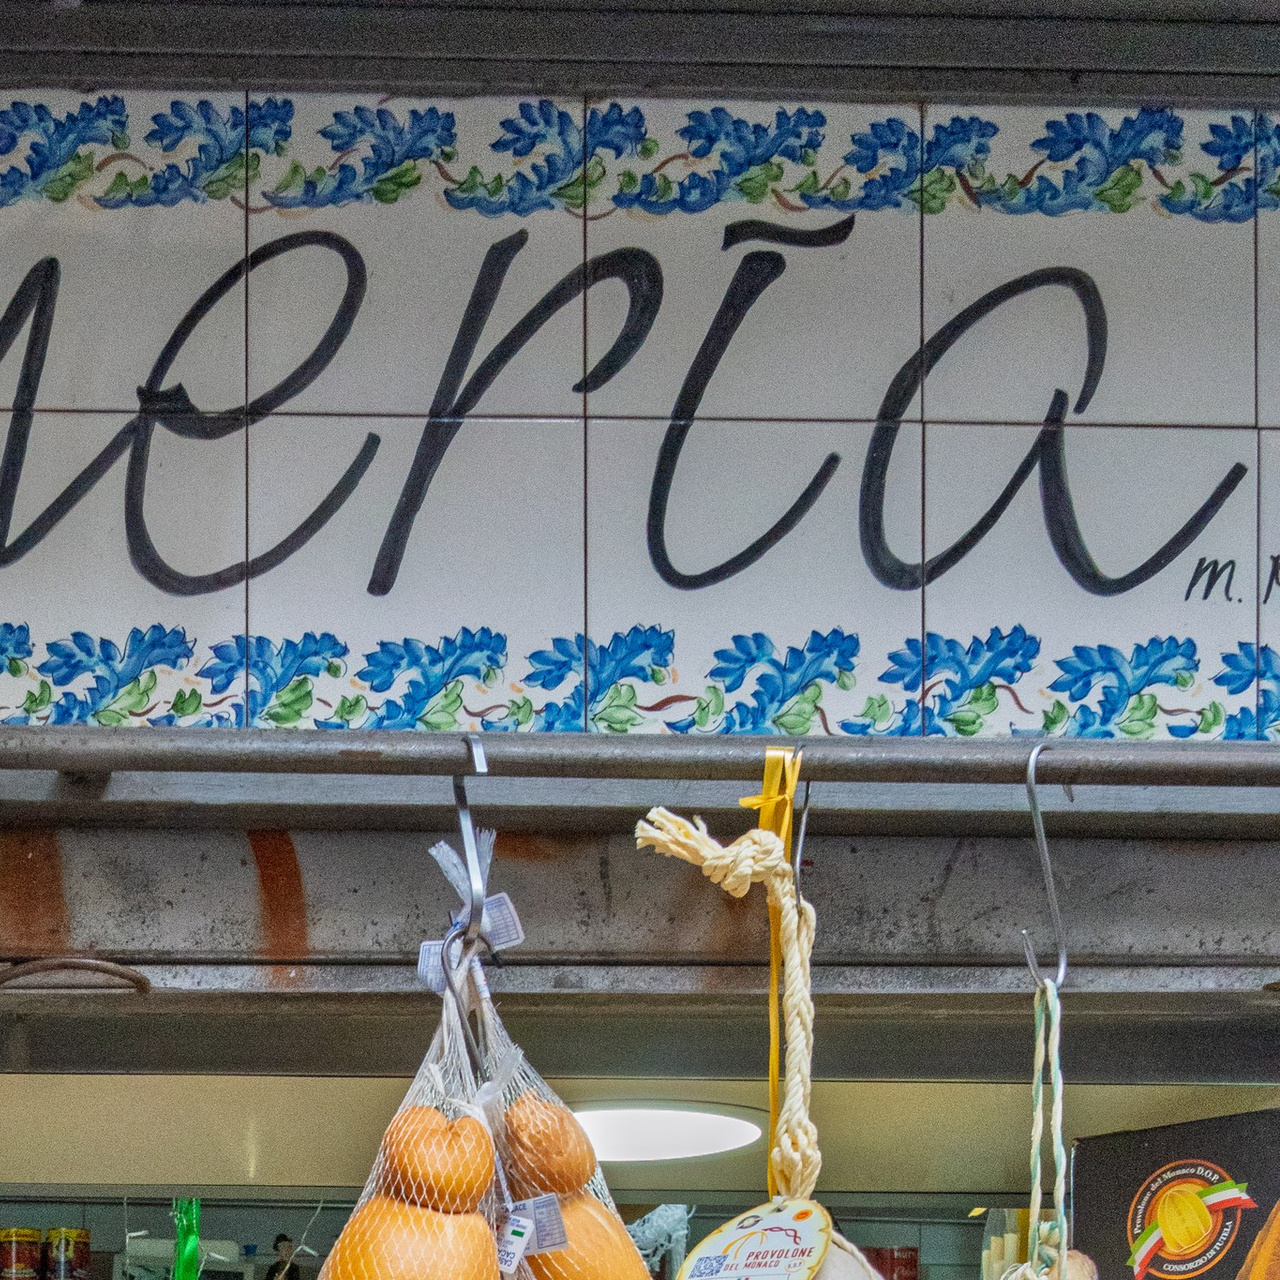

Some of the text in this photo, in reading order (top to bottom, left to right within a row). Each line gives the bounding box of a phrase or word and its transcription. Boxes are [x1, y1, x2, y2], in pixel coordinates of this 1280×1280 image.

[1134, 1192, 1152, 1235] Provolone
[1163, 1167, 1195, 1181] Monaco
[746, 1246, 816, 1262] PROVOLONE
[723, 1263, 739, 1272] DEL
[743, 1260, 781, 1270] MONACO
